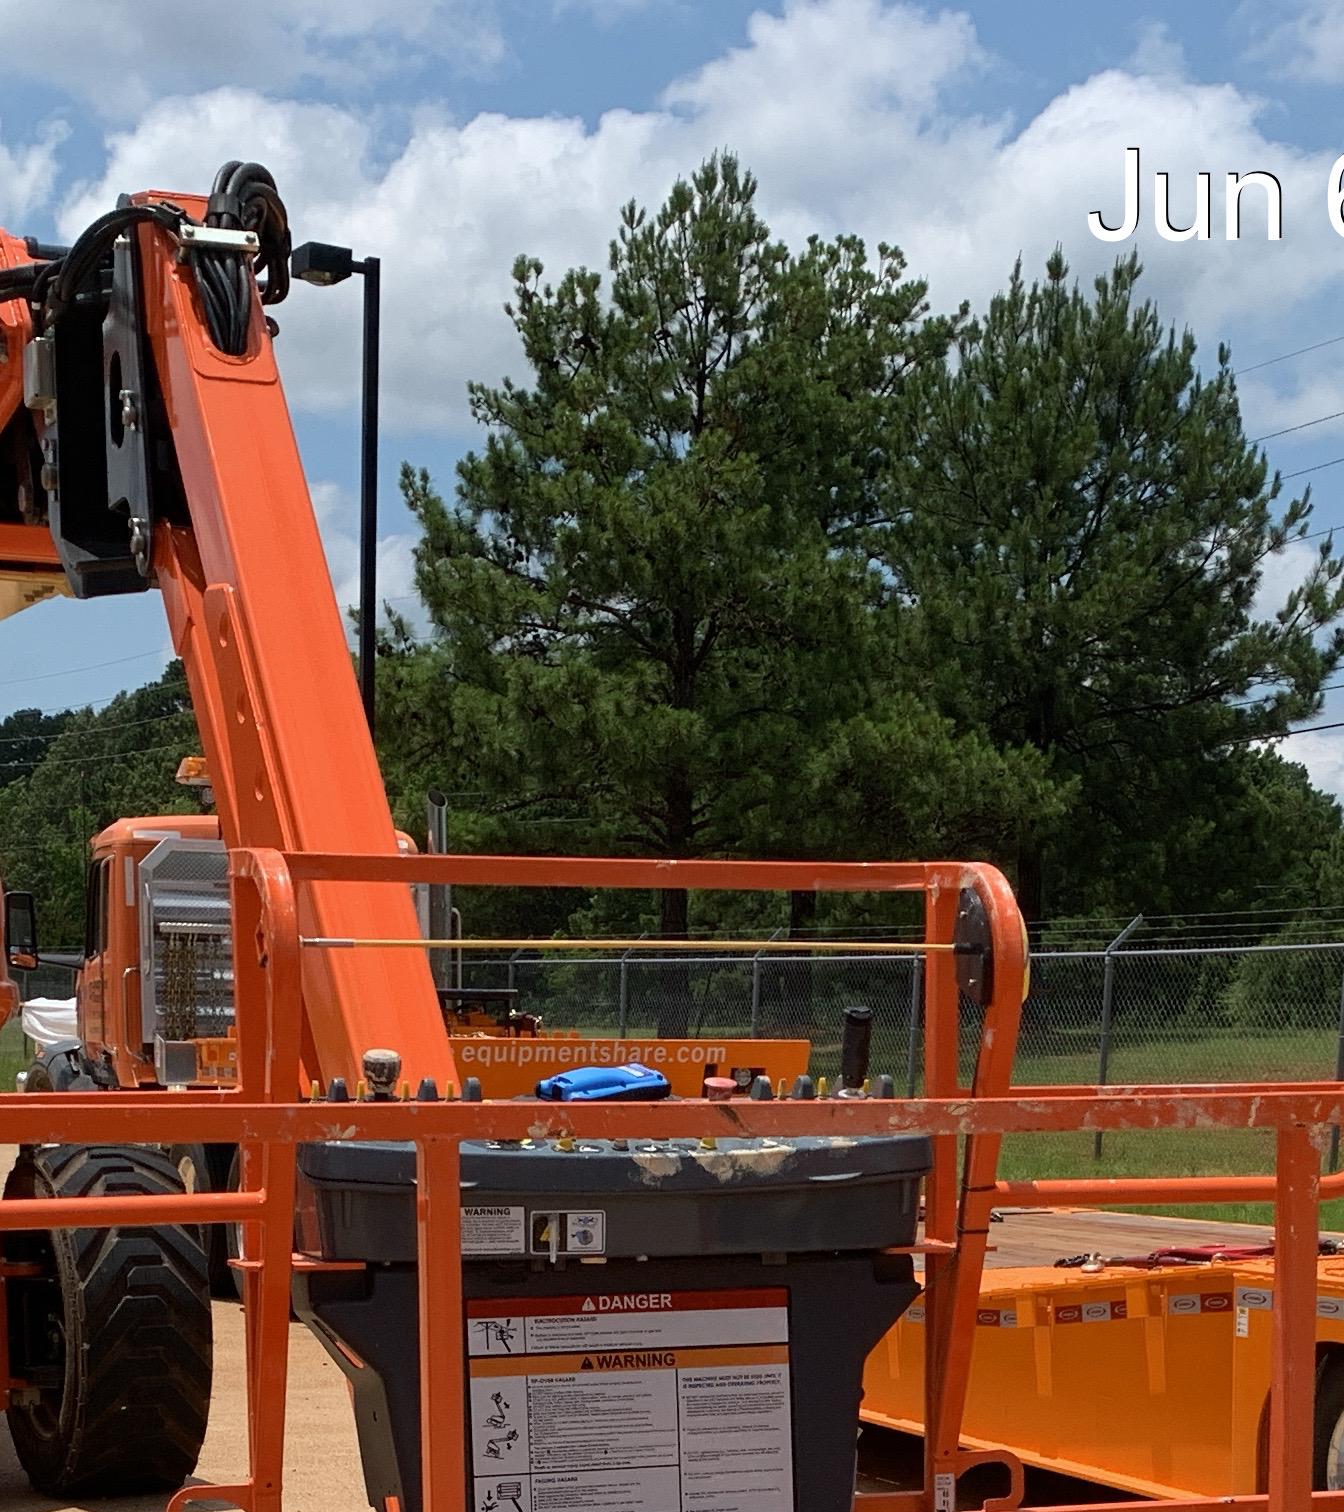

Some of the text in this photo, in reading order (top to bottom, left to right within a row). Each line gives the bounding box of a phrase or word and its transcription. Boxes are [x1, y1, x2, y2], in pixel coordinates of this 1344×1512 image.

[459, 1041, 727, 1067] equipmentshare.com
[464, 1207, 512, 1217] WARNING
[598, 1293, 673, 1311] DANGER
[596, 1352, 676, 1370] WARNING
